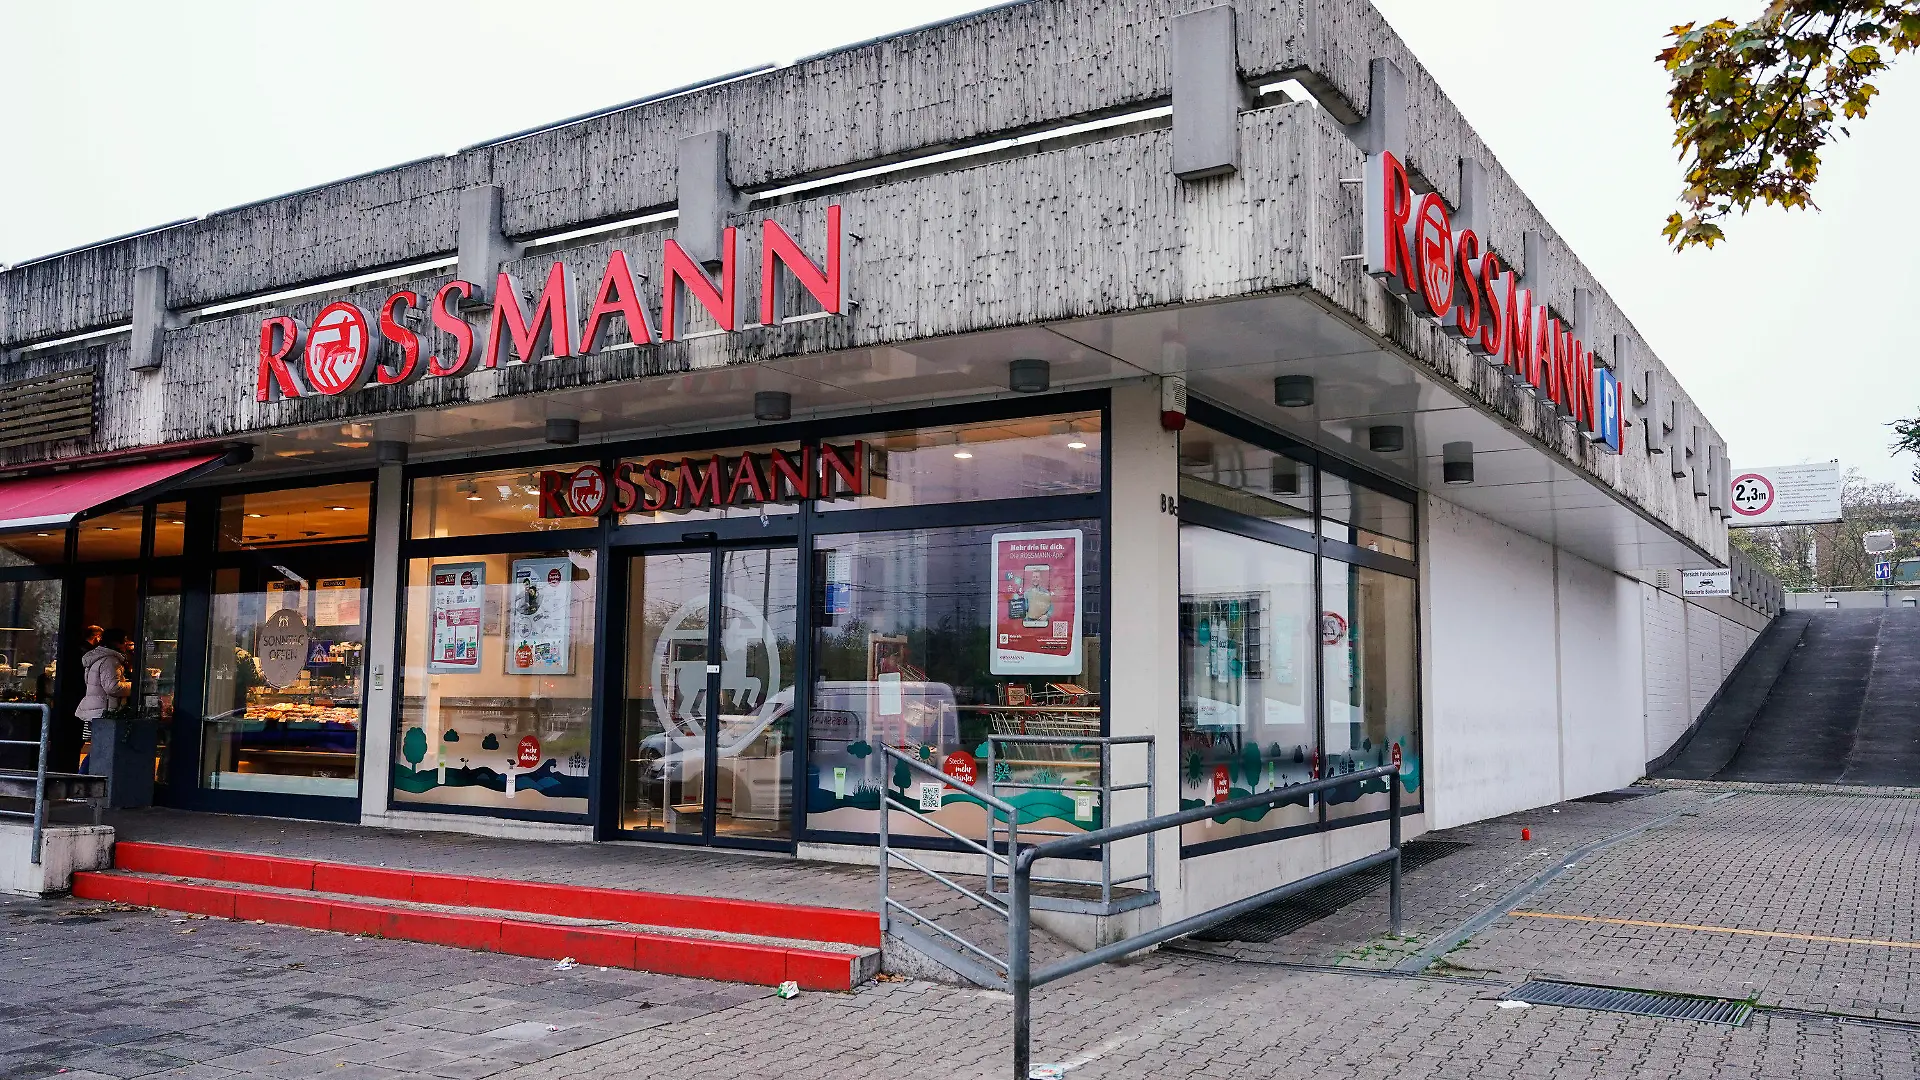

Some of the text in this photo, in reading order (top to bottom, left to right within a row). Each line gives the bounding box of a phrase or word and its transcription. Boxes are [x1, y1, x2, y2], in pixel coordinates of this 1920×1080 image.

[257, 205, 846, 402] ROSSMANN
[1383, 150, 1595, 432] ROSSMANN
[538, 439, 868, 519] ROSSMANN
[956, 764, 971, 772] mehr
